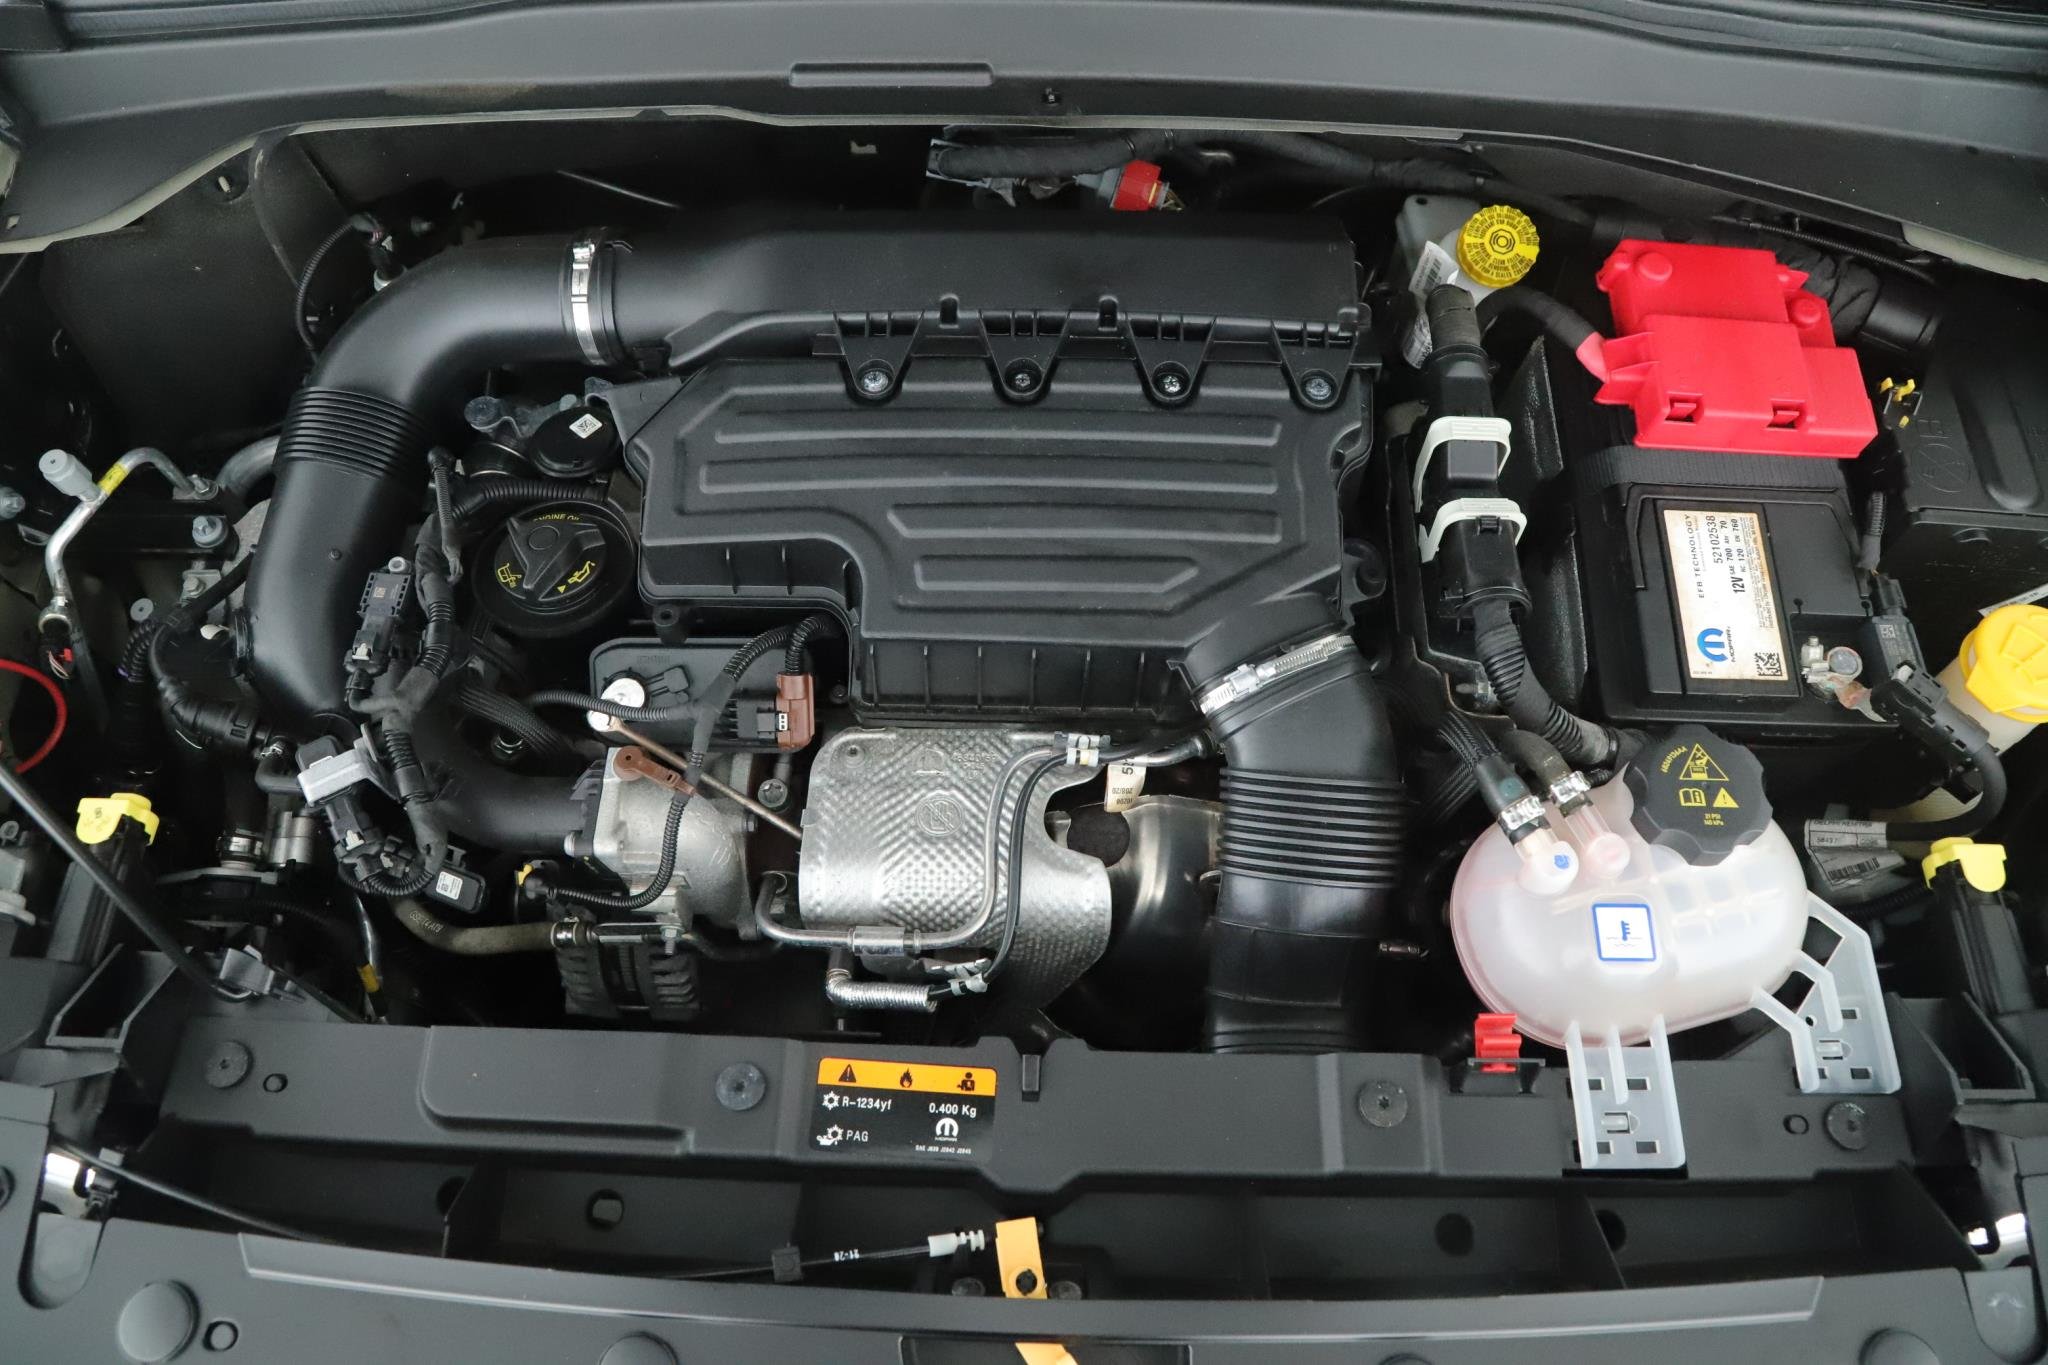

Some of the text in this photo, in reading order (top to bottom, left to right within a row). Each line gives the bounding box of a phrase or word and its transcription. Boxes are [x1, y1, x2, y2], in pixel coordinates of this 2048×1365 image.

[1720, 520, 1728, 529] 70
[1731, 519, 1740, 532] 760
[1684, 514, 1701, 576] TECHNOLOGY
[1705, 515, 1724, 564] 52102538
[1725, 548, 1734, 561] 700
[1736, 548, 1745, 562] 120
[1697, 581, 1705, 598] EFB
[1730, 576, 1746, 594] 12V
[842, 1096, 977, 1119] R-1234yf 0.400 Kg
[847, 1130, 869, 1142] PAG
